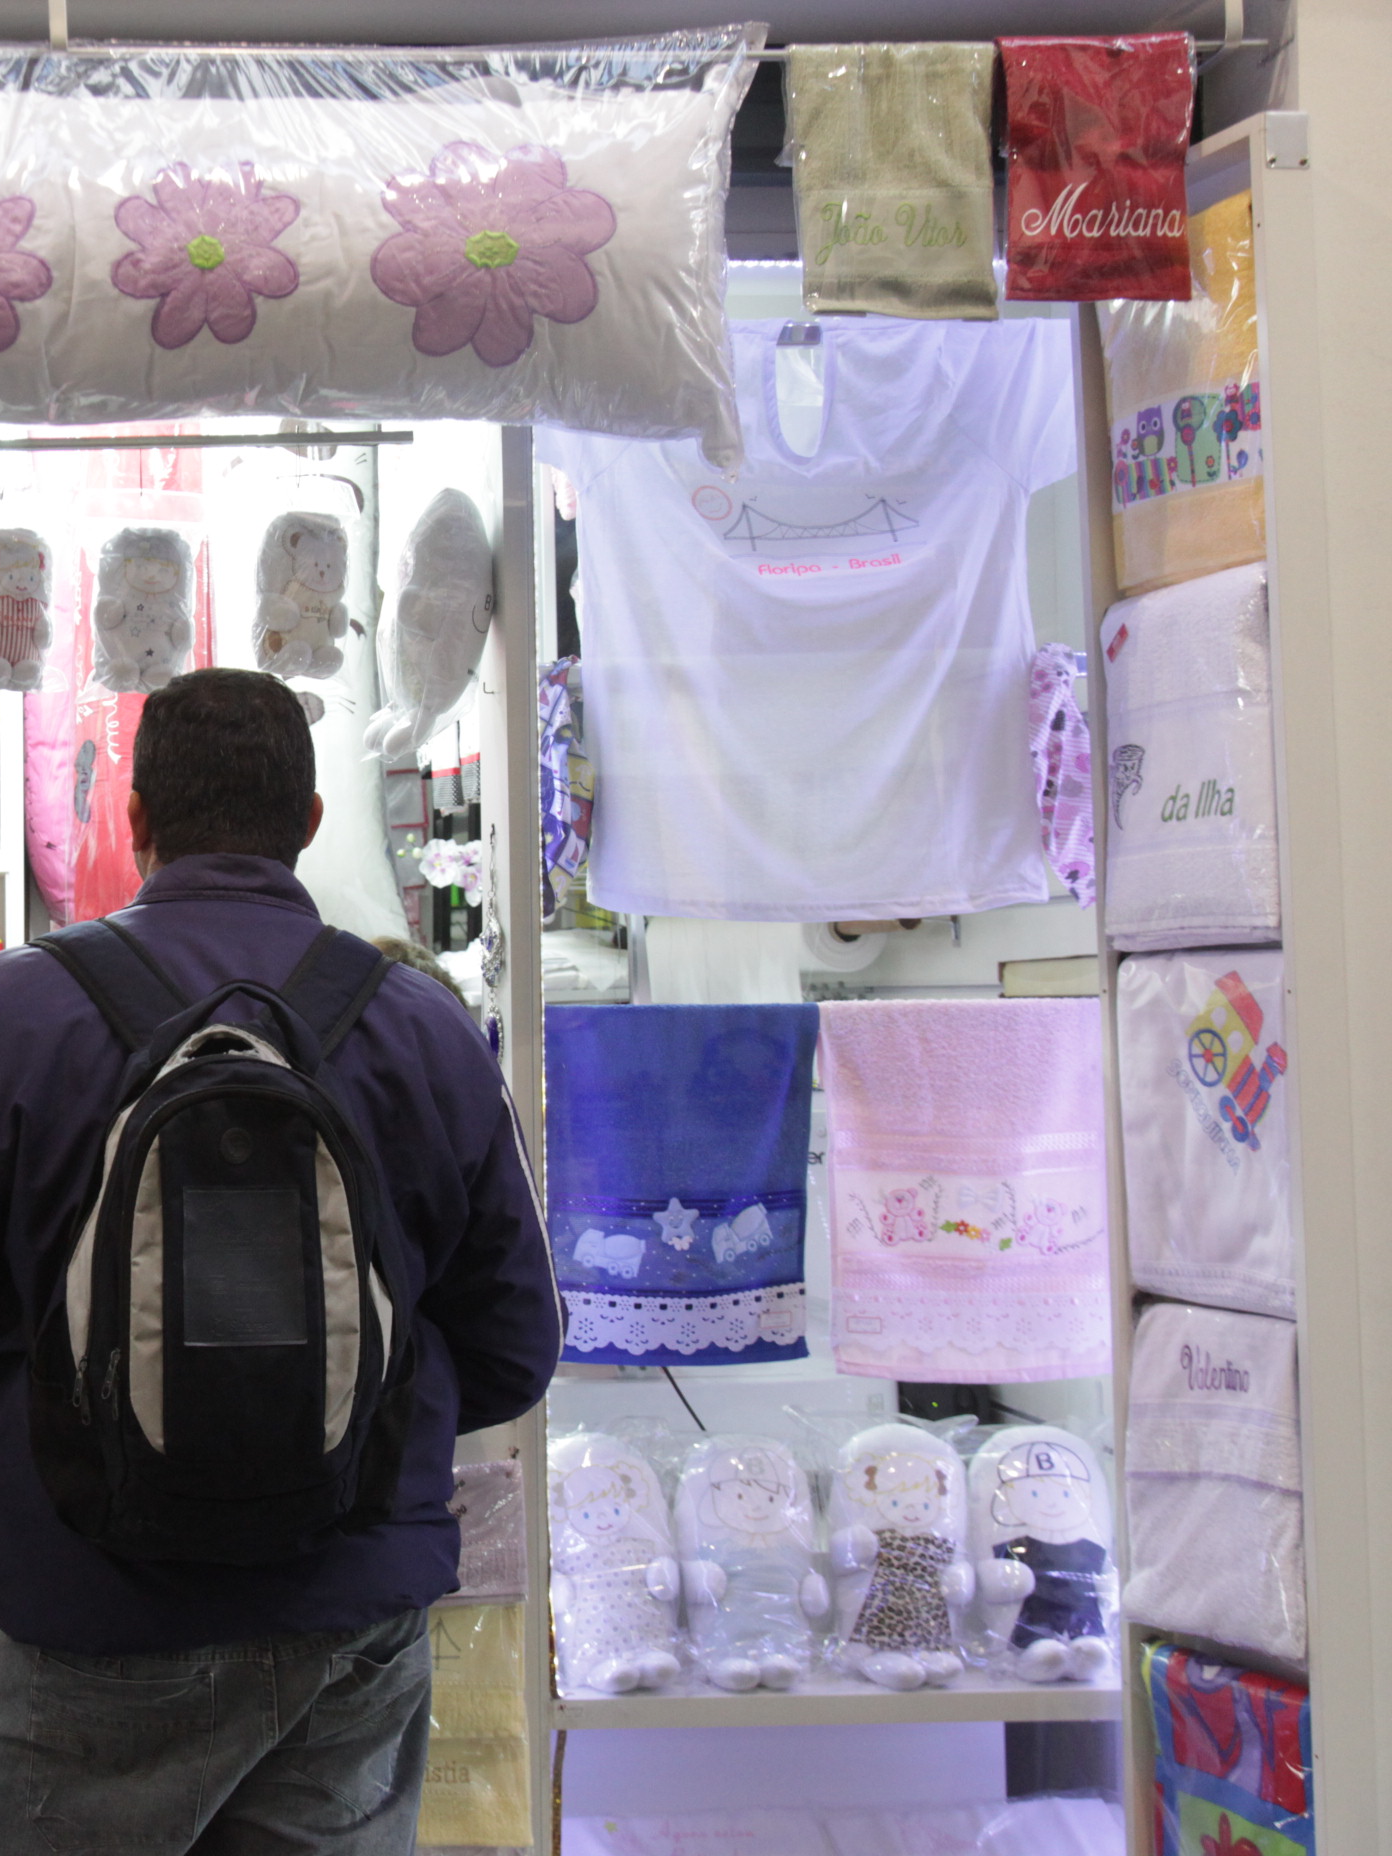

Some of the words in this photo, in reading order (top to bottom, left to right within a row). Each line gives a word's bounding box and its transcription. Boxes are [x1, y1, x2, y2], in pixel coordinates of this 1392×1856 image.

[814, 201, 888, 265] João
[894, 201, 968, 248] Vitor
[1021, 182, 1185, 241] Mariana
[757, 562, 822, 577] Floripa
[848, 553, 903, 570] Brasil
[1160, 783, 1190, 823] da
[1194, 779, 1236, 819] Ilha
[1034, 1452, 1055, 1472] B
